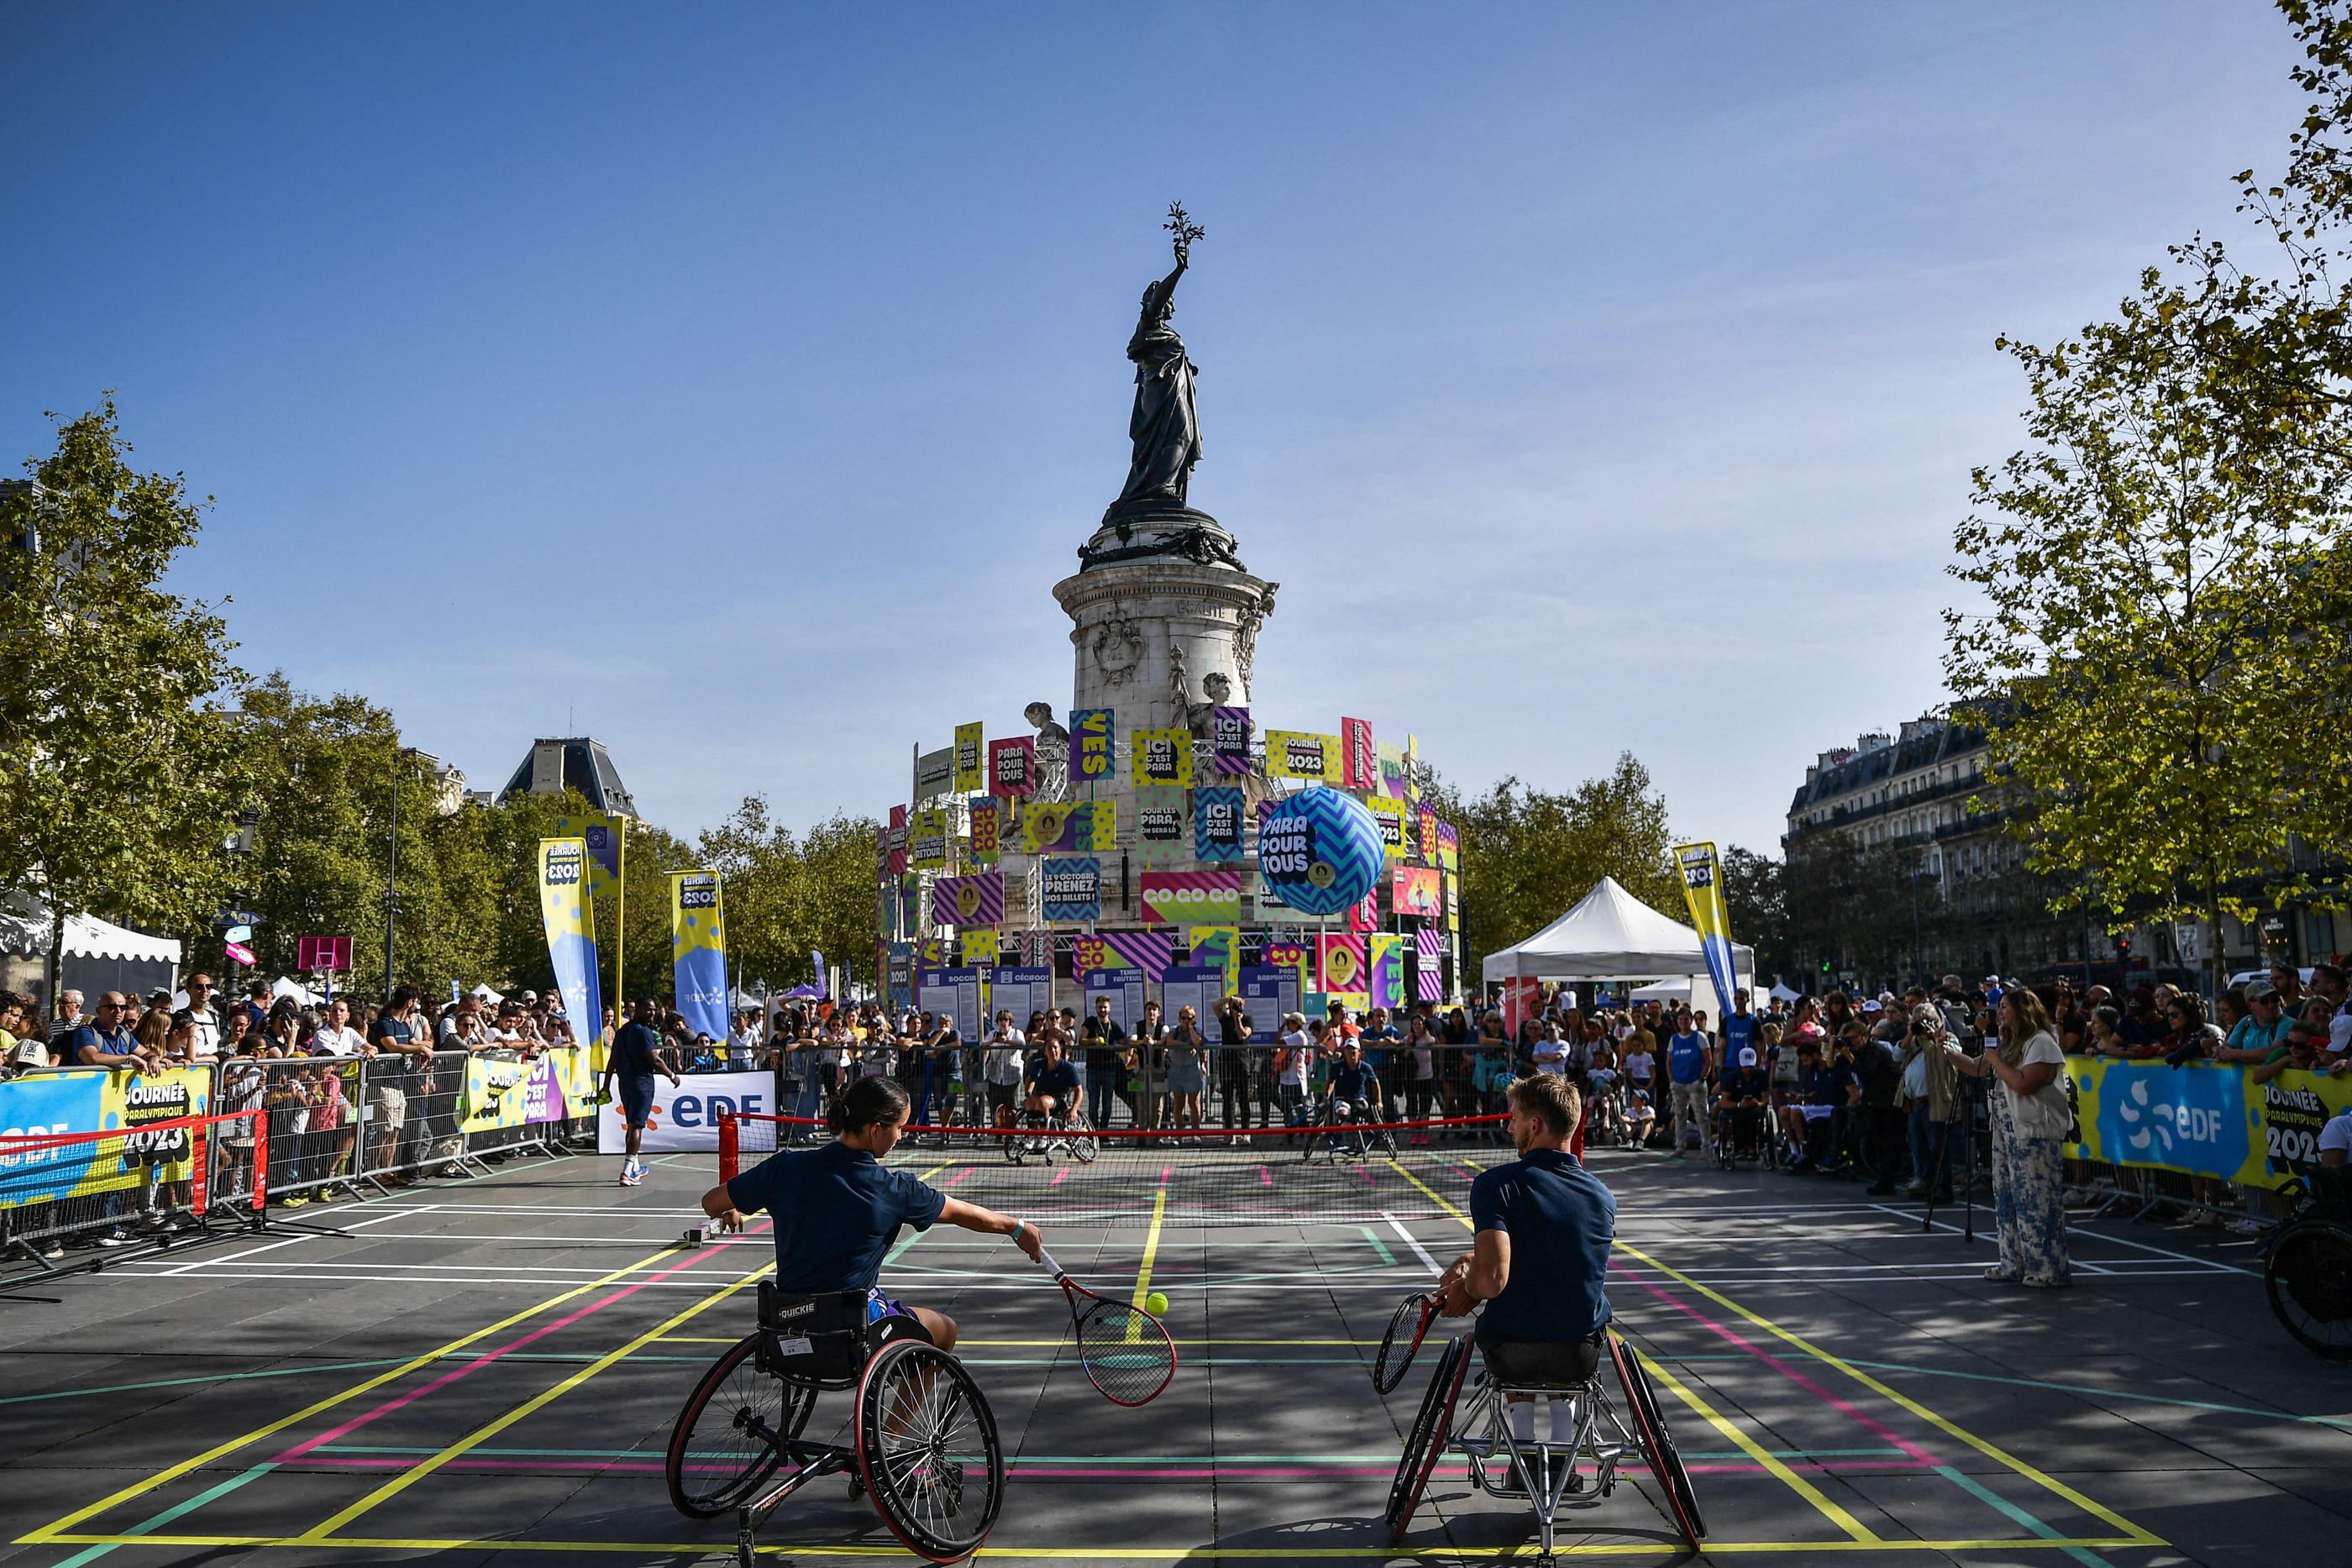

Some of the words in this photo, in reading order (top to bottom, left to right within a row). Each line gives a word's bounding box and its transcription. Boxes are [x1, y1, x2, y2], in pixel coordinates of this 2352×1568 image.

[1218, 718, 1242, 732] ICI
[1082, 713, 1106, 774] YES
[1217, 733, 1242, 742] C'EST
[1287, 738, 1320, 749] JOURNÉE
[959, 741, 975, 752] PARA
[997, 746, 1023, 760] PARA
[1146, 740, 1172, 753] ICI
[1218, 742, 1242, 750] PARA
[959, 751, 975, 759] POUR
[1286, 754, 1322, 770] 2023
[959, 759, 975, 768] TOUS
[997, 758, 1024, 770] POUR
[1145, 763, 1172, 771] PARA
[1380, 758, 1399, 779] YES
[997, 768, 1024, 781] TOUS
[972, 805, 997, 821] GO
[1206, 804, 1231, 819] ICI
[1420, 811, 1435, 826] GO
[1075, 801, 1094, 851] YES
[1141, 815, 1177, 826] PARA,
[1263, 815, 1308, 836] PARA
[972, 821, 997, 836] GO
[1206, 828, 1232, 836] PARA
[1421, 825, 1435, 840] GO
[972, 836, 997, 852] GO
[1262, 835, 1308, 855] POUR
[1421, 840, 1435, 854] GO
[916, 847, 941, 858] RETOUR
[1262, 853, 1309, 874] TOUS
[1060, 873, 1097, 881] OCTOBRE,
[1045, 879, 1095, 893] PRENEZ
[1260, 885, 1271, 894] LE
[1063, 893, 1091, 901] BILLETS
[1142, 888, 1173, 903] GO
[1176, 888, 1206, 903] GO
[1209, 887, 1239, 902] GO
[1077, 937, 1105, 952] GO
[1077, 952, 1105, 966] GO
[1268, 946, 1302, 963] GO
[1014, 973, 1049, 982] CÉCIFOOT
[1387, 941, 1404, 1001] YES
[124, 1080, 186, 1105] JOURNÉE
[124, 1105, 184, 1121] PARALYMPIQUE
[523, 1101, 548, 1120] PARA
[123, 1124, 183, 1155] 2023
[2266, 1126, 2323, 1164] 202
[781, 1303, 815, 1319] QUICKIE
